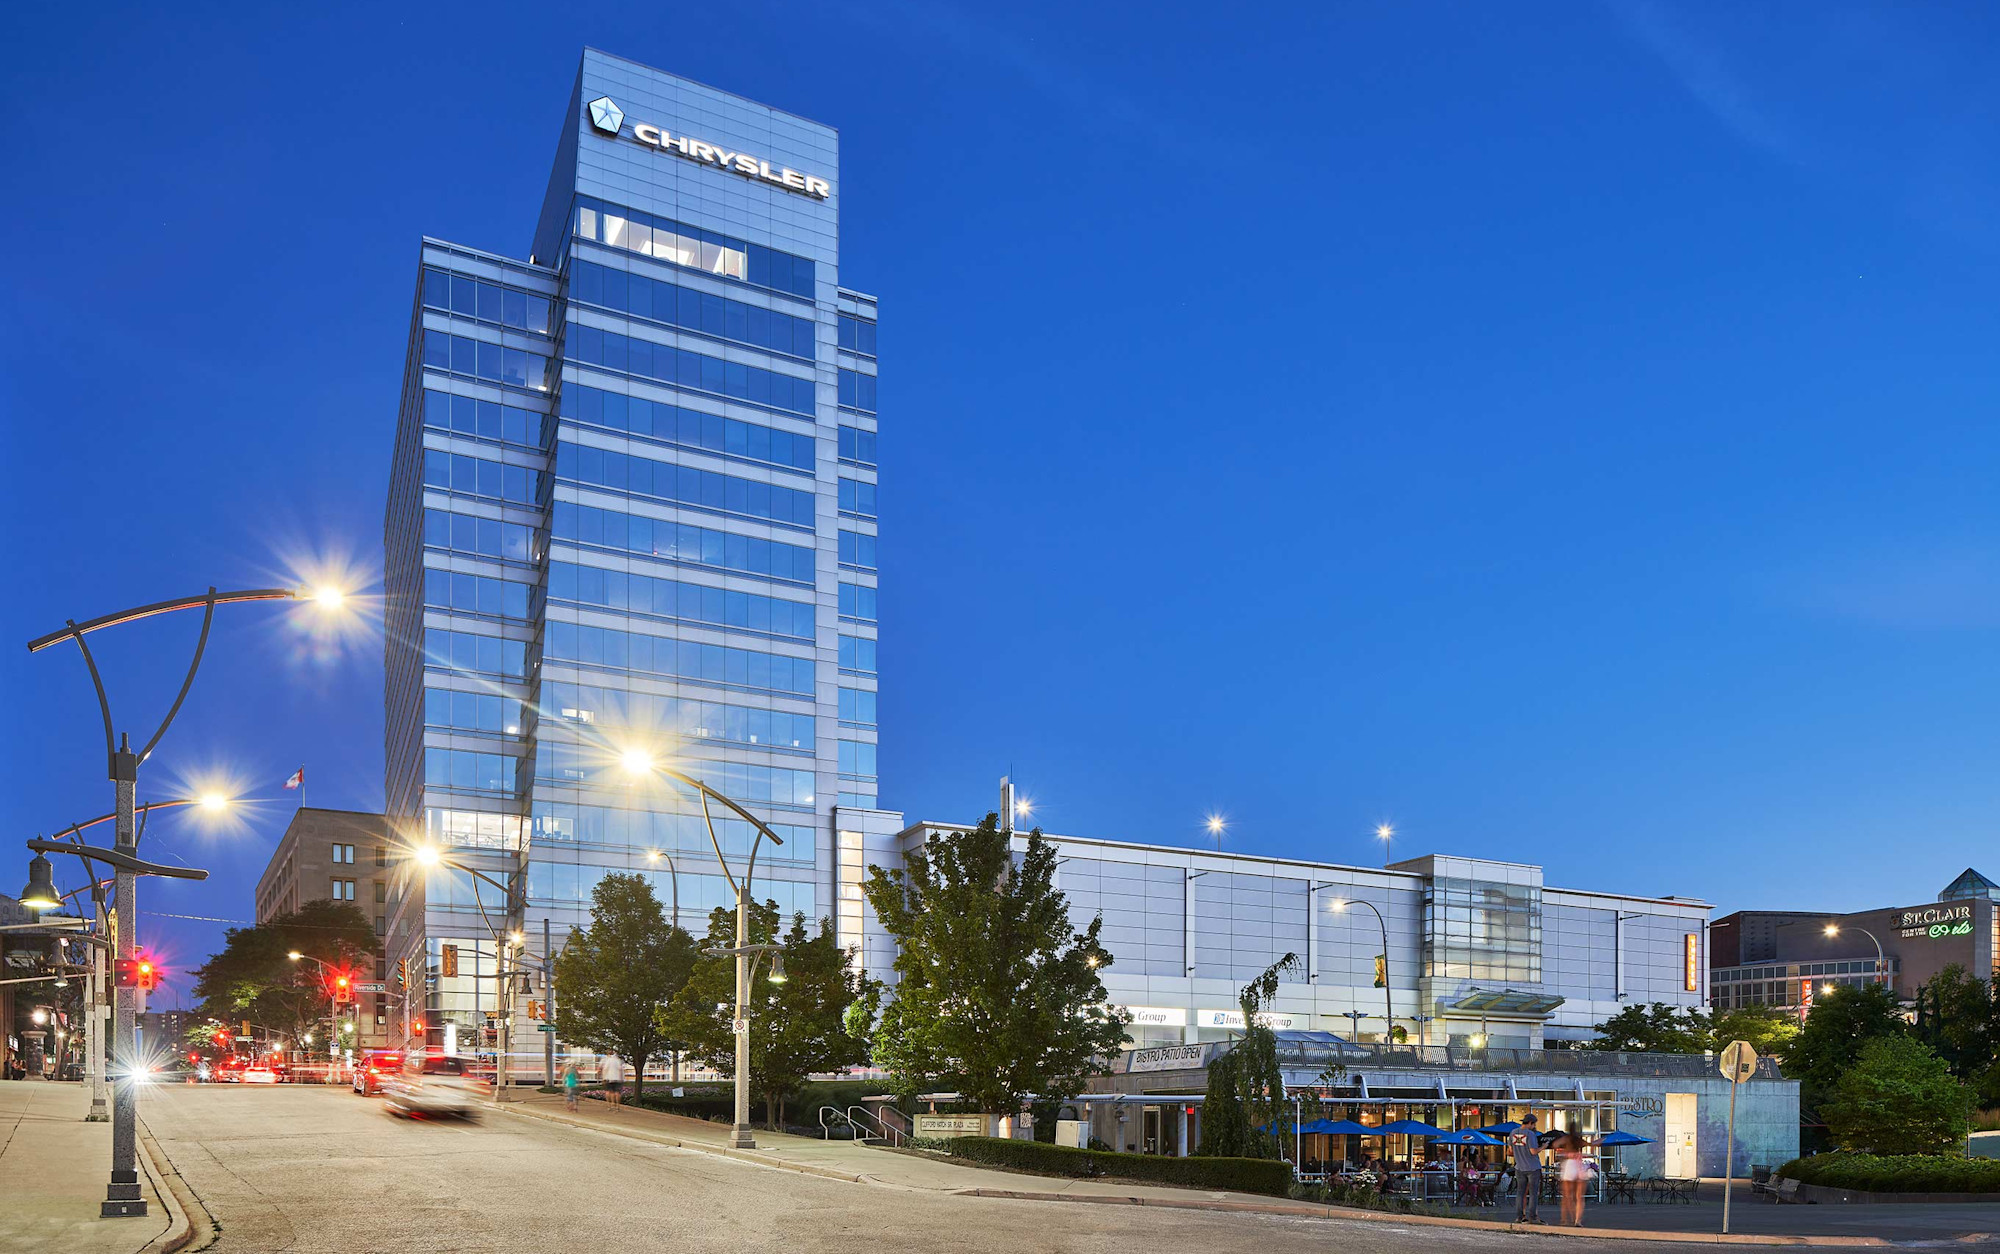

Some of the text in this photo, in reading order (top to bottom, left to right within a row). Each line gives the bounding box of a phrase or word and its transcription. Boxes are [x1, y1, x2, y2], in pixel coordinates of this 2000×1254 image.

[634, 124, 829, 198] CHRYSLER
[1923, 906, 1971, 922] CLAIR
[1138, 1010, 1166, 1023] Group
[1136, 1046, 1202, 1063] BISTRO PATIO OPEN
[1624, 1096, 1663, 1113] BISTRO
